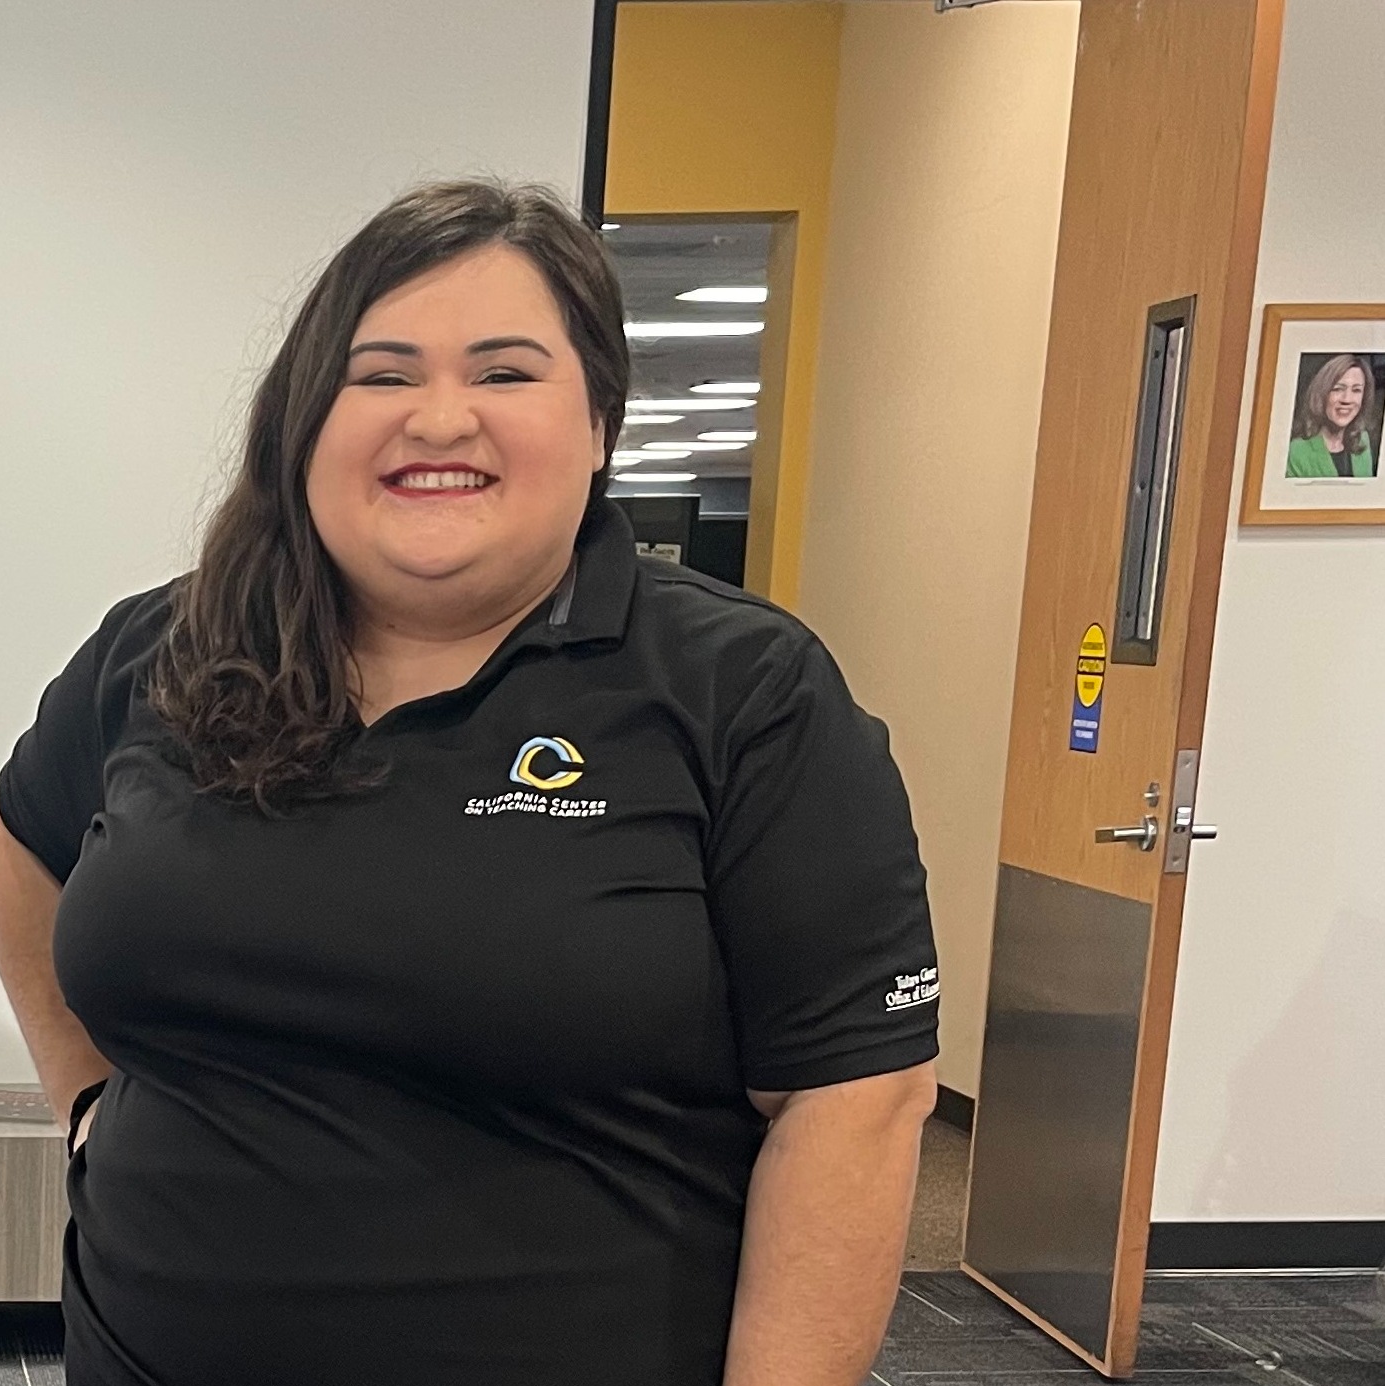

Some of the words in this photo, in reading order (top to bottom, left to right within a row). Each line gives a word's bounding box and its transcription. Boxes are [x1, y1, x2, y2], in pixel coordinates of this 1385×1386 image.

[467, 791, 548, 808] CALIFORNIA
[551, 798, 607, 809] CENTER
[464, 806, 483, 816] ON
[486, 801, 547, 815] TEACHING
[549, 807, 606, 817] CAREERS
